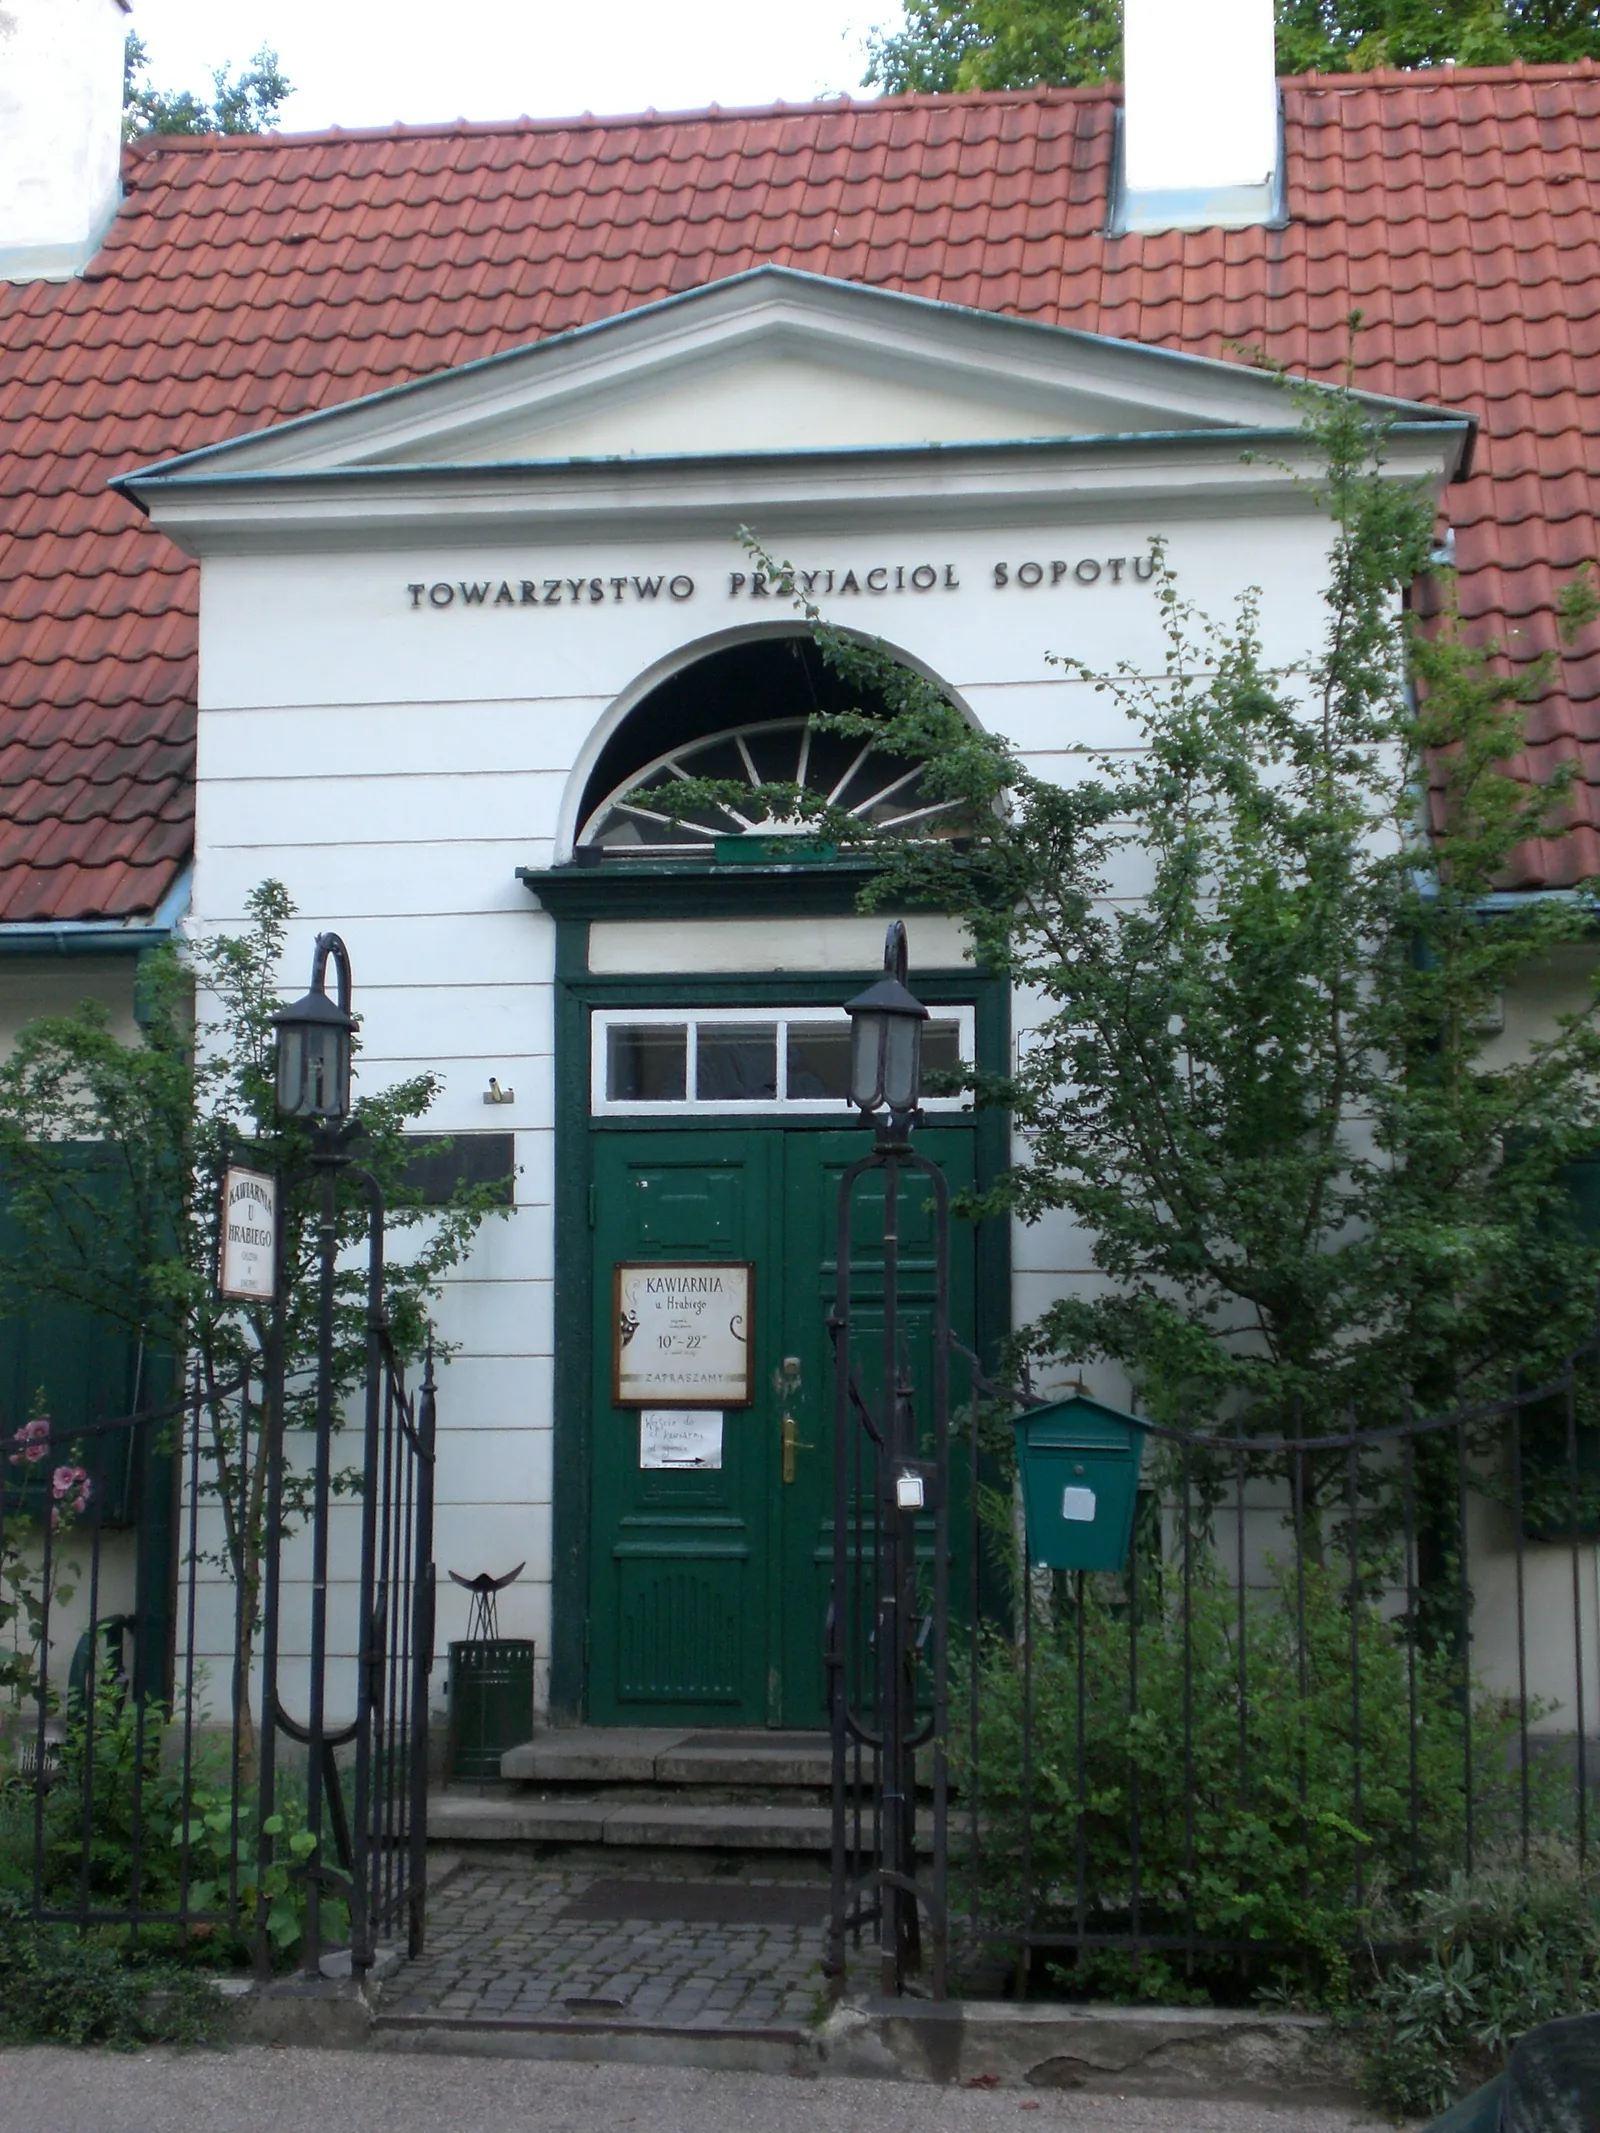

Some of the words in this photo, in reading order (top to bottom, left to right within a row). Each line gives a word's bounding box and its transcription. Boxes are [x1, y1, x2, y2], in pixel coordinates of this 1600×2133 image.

[407, 575, 696, 606] TOWARZYSTWO
[993, 556, 1155, 586] SOPOTU
[228, 1181, 273, 1216] KAWIARNIA
[247, 1204, 254, 1222] U
[228, 1224, 272, 1248] HRABIEGO
[646, 1277, 723, 1293] KAWIARNIA
[667, 1296, 707, 1315] Hrabiego
[645, 1373, 724, 1383] ZAPRASZAMY
